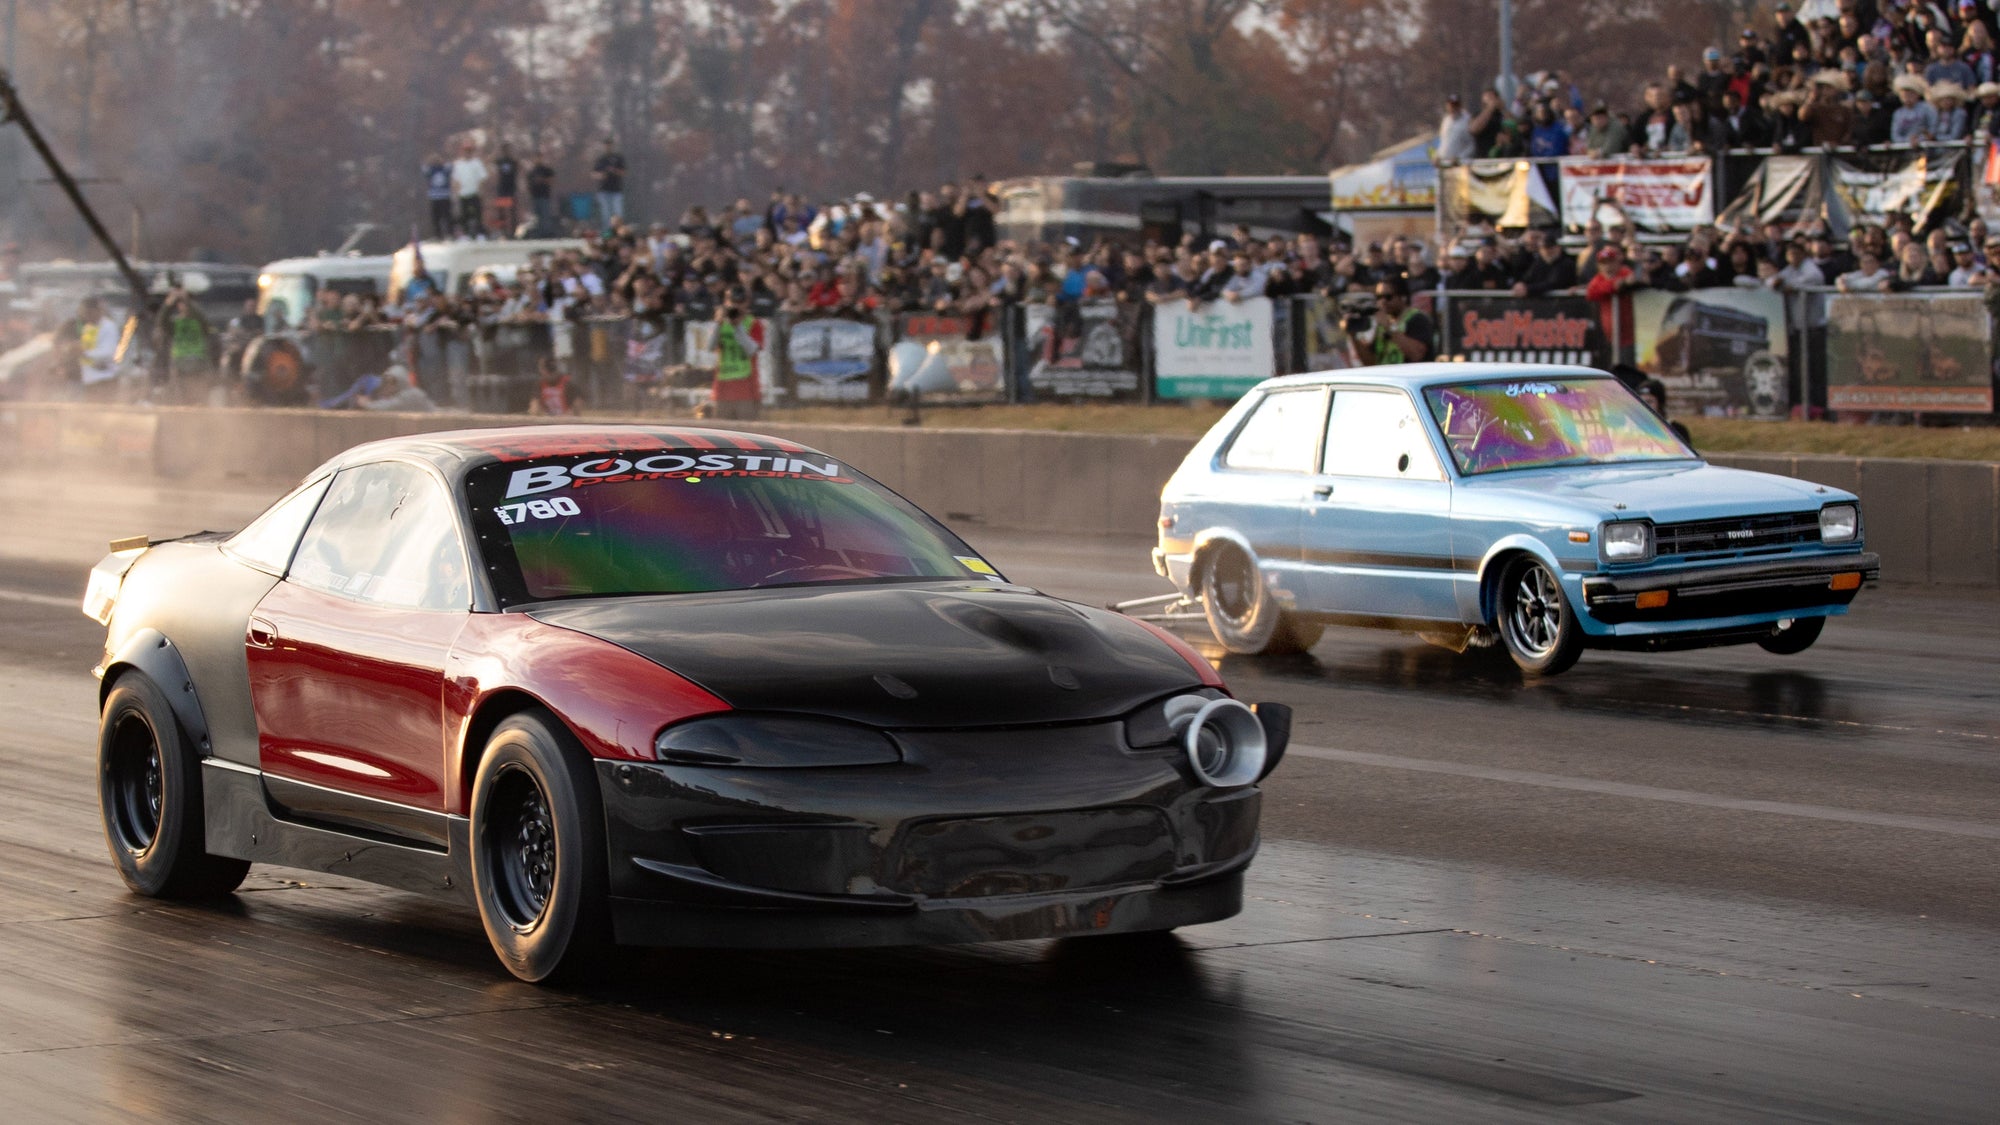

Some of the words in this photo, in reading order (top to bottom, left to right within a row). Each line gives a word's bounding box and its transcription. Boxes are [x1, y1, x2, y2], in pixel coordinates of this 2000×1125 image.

[1462, 310, 1587, 348] SealMaster
[505, 455, 838, 499] BOOSTIN
[502, 496, 581, 523] 780
[1728, 530, 1754, 539] TOYOTA
